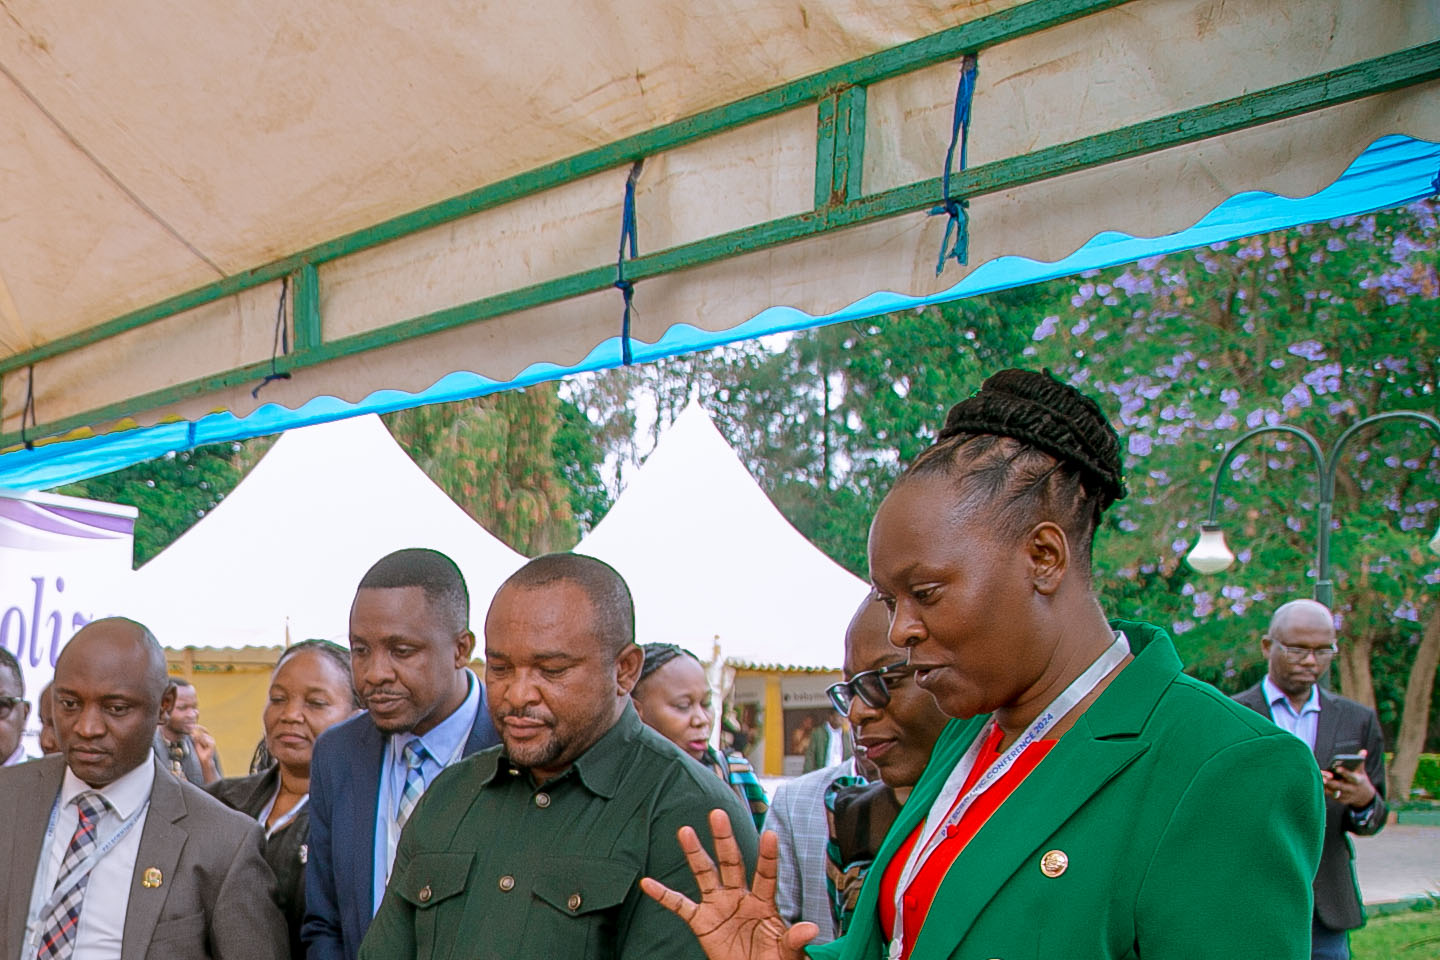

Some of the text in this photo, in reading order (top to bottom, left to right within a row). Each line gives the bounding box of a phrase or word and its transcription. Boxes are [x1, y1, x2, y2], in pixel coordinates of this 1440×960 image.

[941, 818, 953, 837] PT
[986, 731, 1036, 780] CONFERENCE
[1033, 712, 1054, 734] 2024
